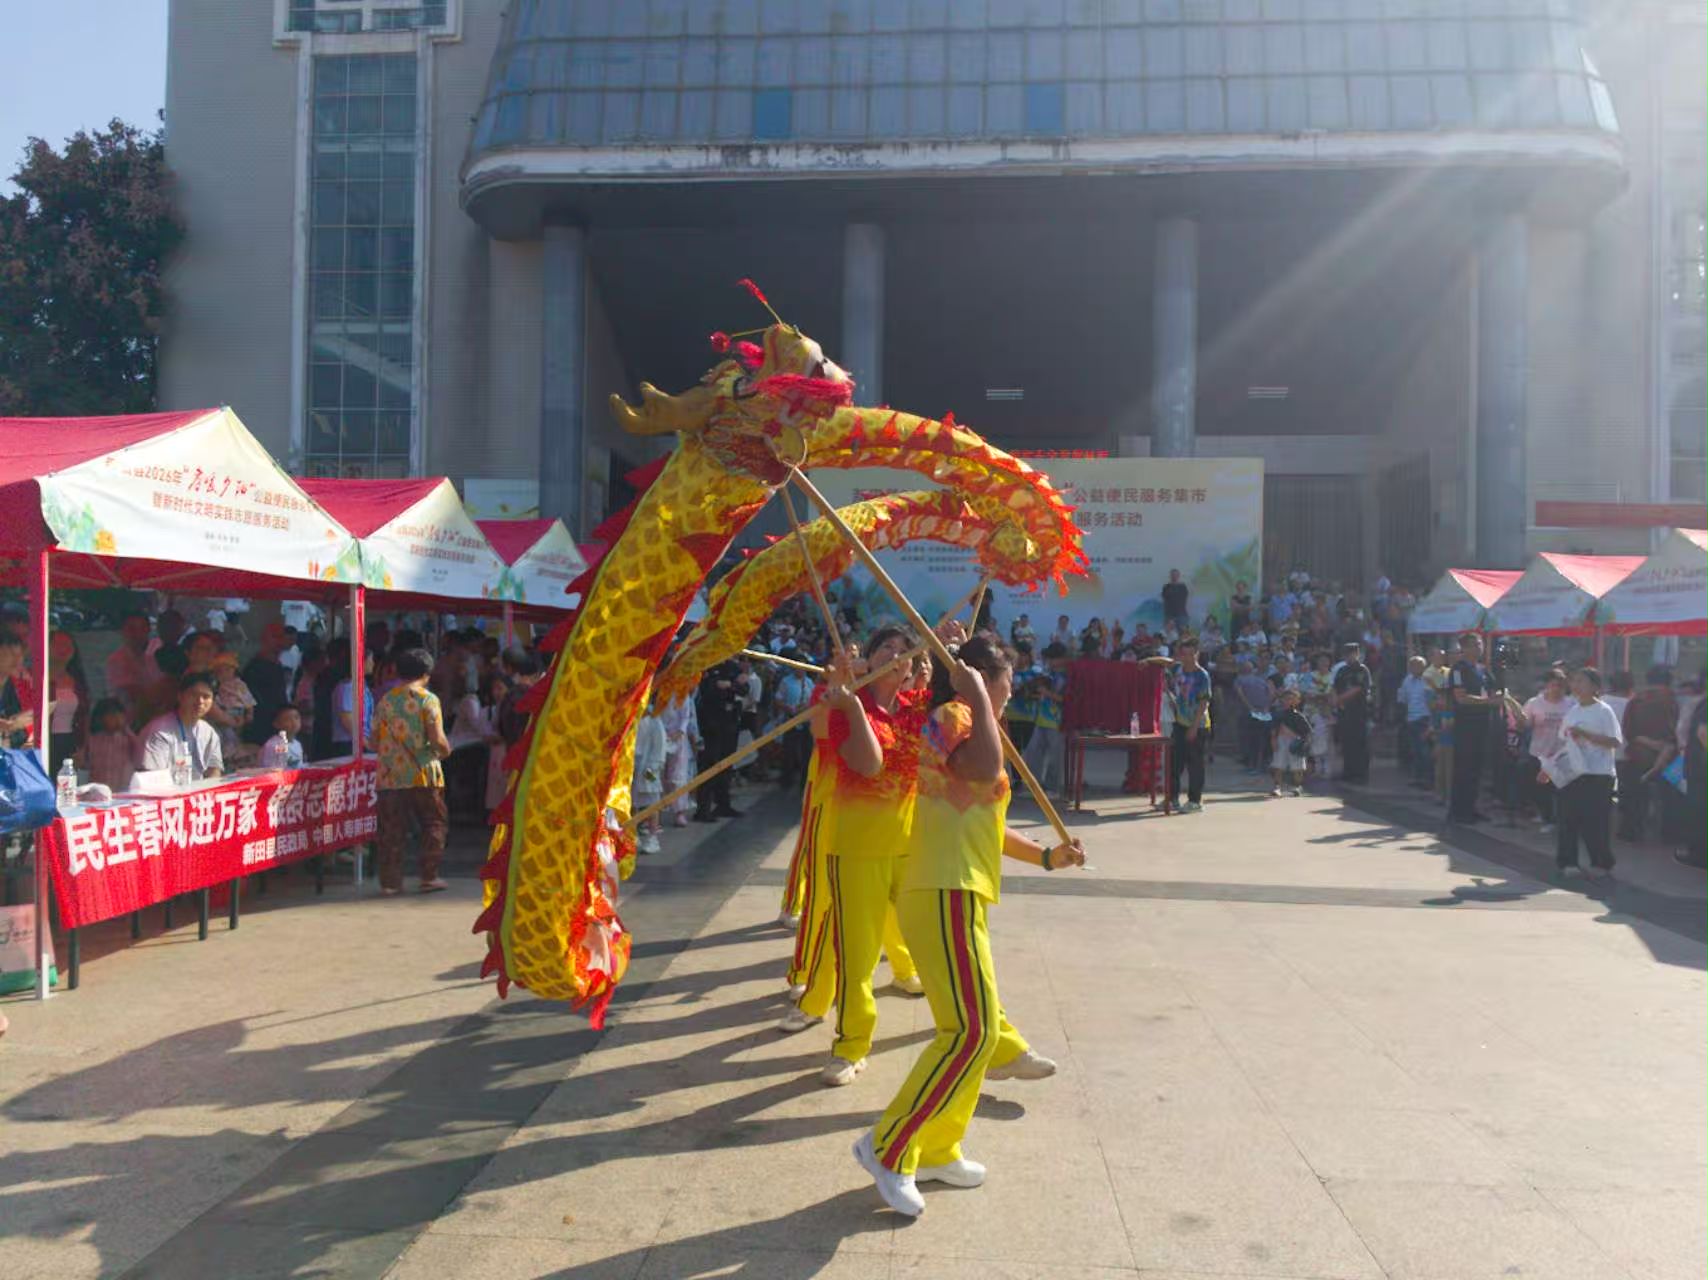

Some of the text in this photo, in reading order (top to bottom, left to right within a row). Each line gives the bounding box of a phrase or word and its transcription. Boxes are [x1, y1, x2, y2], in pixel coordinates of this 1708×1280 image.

[65, 786, 262, 877] 民生春风进万家
